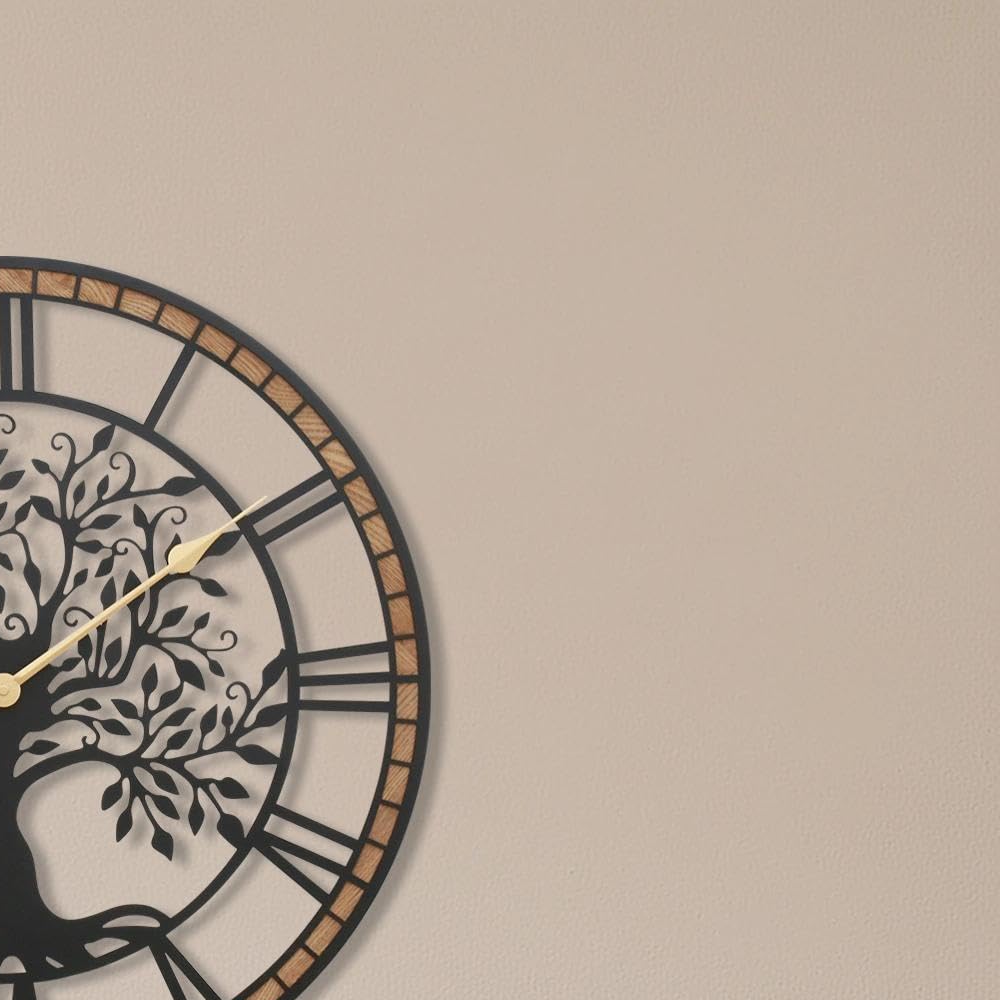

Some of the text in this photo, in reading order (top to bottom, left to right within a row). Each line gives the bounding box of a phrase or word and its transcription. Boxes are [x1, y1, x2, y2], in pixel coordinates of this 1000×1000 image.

[238, 470, 345, 546] II
[297, 640, 393, 713] III
[252, 804, 361, 904] IV
